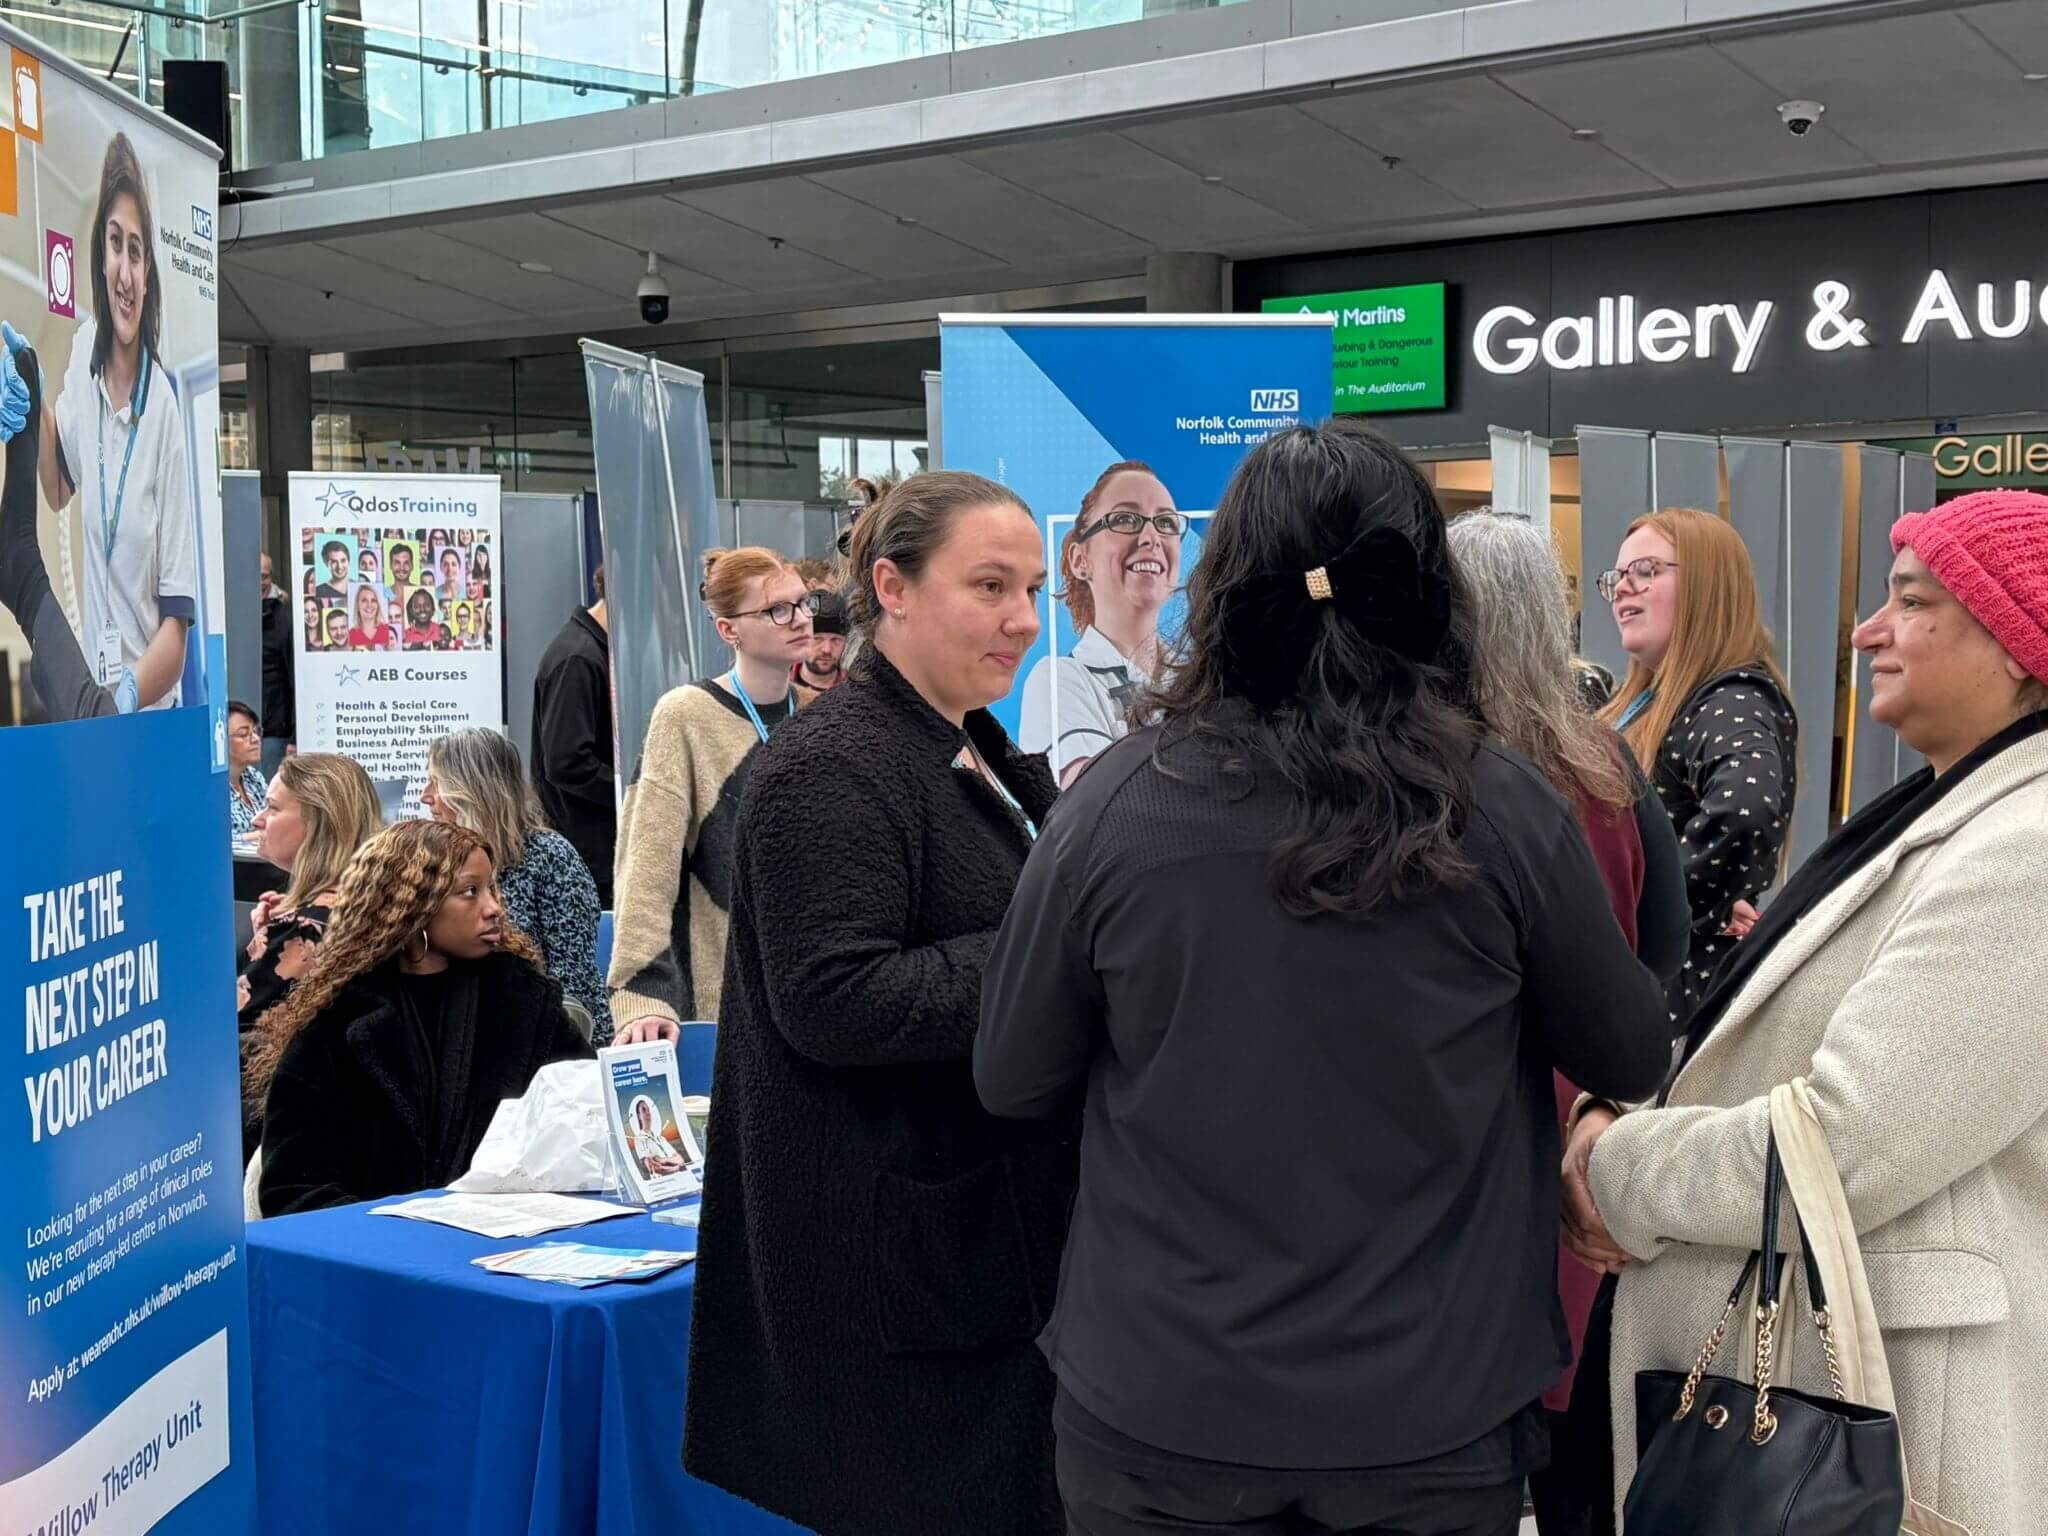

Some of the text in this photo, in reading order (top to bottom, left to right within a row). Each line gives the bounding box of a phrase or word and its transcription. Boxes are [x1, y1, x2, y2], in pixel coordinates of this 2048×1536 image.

[192, 206, 212, 241] NHS
[183, 237, 213, 267] Community
[172, 252, 191, 275] Health
[192, 264, 203, 280] and
[1343, 306, 1406, 328] Martins
[1472, 295, 1773, 374] Gallery
[1805, 280, 1872, 352] &
[1333, 343, 1366, 354] urbing
[1378, 337, 1433, 351] Dangerous
[1333, 356, 1399, 369] viour Training
[1335, 380, 1426, 396] in The Auditorium
[1253, 391, 1297, 410] NHS
[1176, 416, 1299, 429] Norfolk Community
[1200, 431, 1267, 444] Health and
[368, 668, 468, 681] AEB Courses
[336, 700, 458, 710] Health & Social Care
[336, 713, 469, 724] Personal Development
[336, 726, 450, 737] Employability Skills
[336, 739, 388, 748] Business
[382, 763, 421, 772] Health
[24, 869, 124, 963] TAKE THE
[25, 939, 159, 1055] NEXT STEP IN
[24, 1019, 168, 1143] YOUR CAREER
[27, 1132, 202, 1249] Looking for the next step in your career?
[26, 1159, 213, 1282] We're recruiting for a range of clinical roles
[27, 1189, 208, 1316] in our new therapy-led centre in Norwich.
[28, 1364, 64, 1403] Apply
[67, 1356, 80, 1380] at:
[102, 1433, 162, 1508] Therapy
[166, 1399, 202, 1450] Unit
